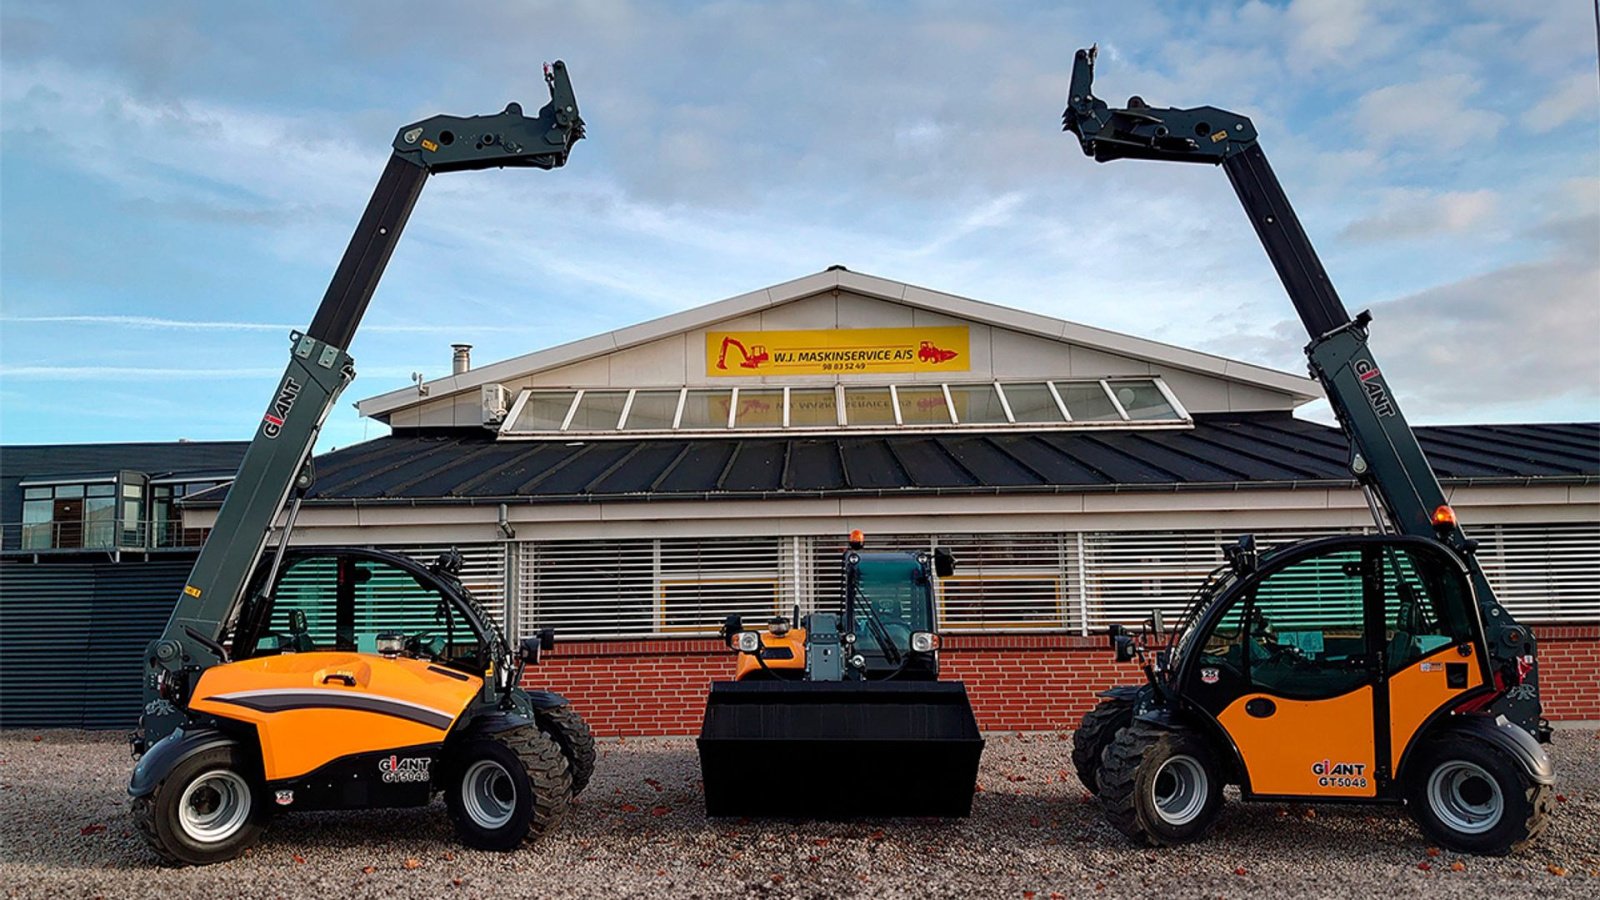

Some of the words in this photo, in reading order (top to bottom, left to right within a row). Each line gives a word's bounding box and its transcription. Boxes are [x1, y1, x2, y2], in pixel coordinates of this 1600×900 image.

[774, 352, 796, 363] W.J.
[798, 349, 891, 362] MASKINSERVICE
[893, 349, 913, 360] A/S
[844, 362, 854, 370] 52
[382, 770, 430, 783] GT5048
[1318, 776, 1367, 788] GT5048
